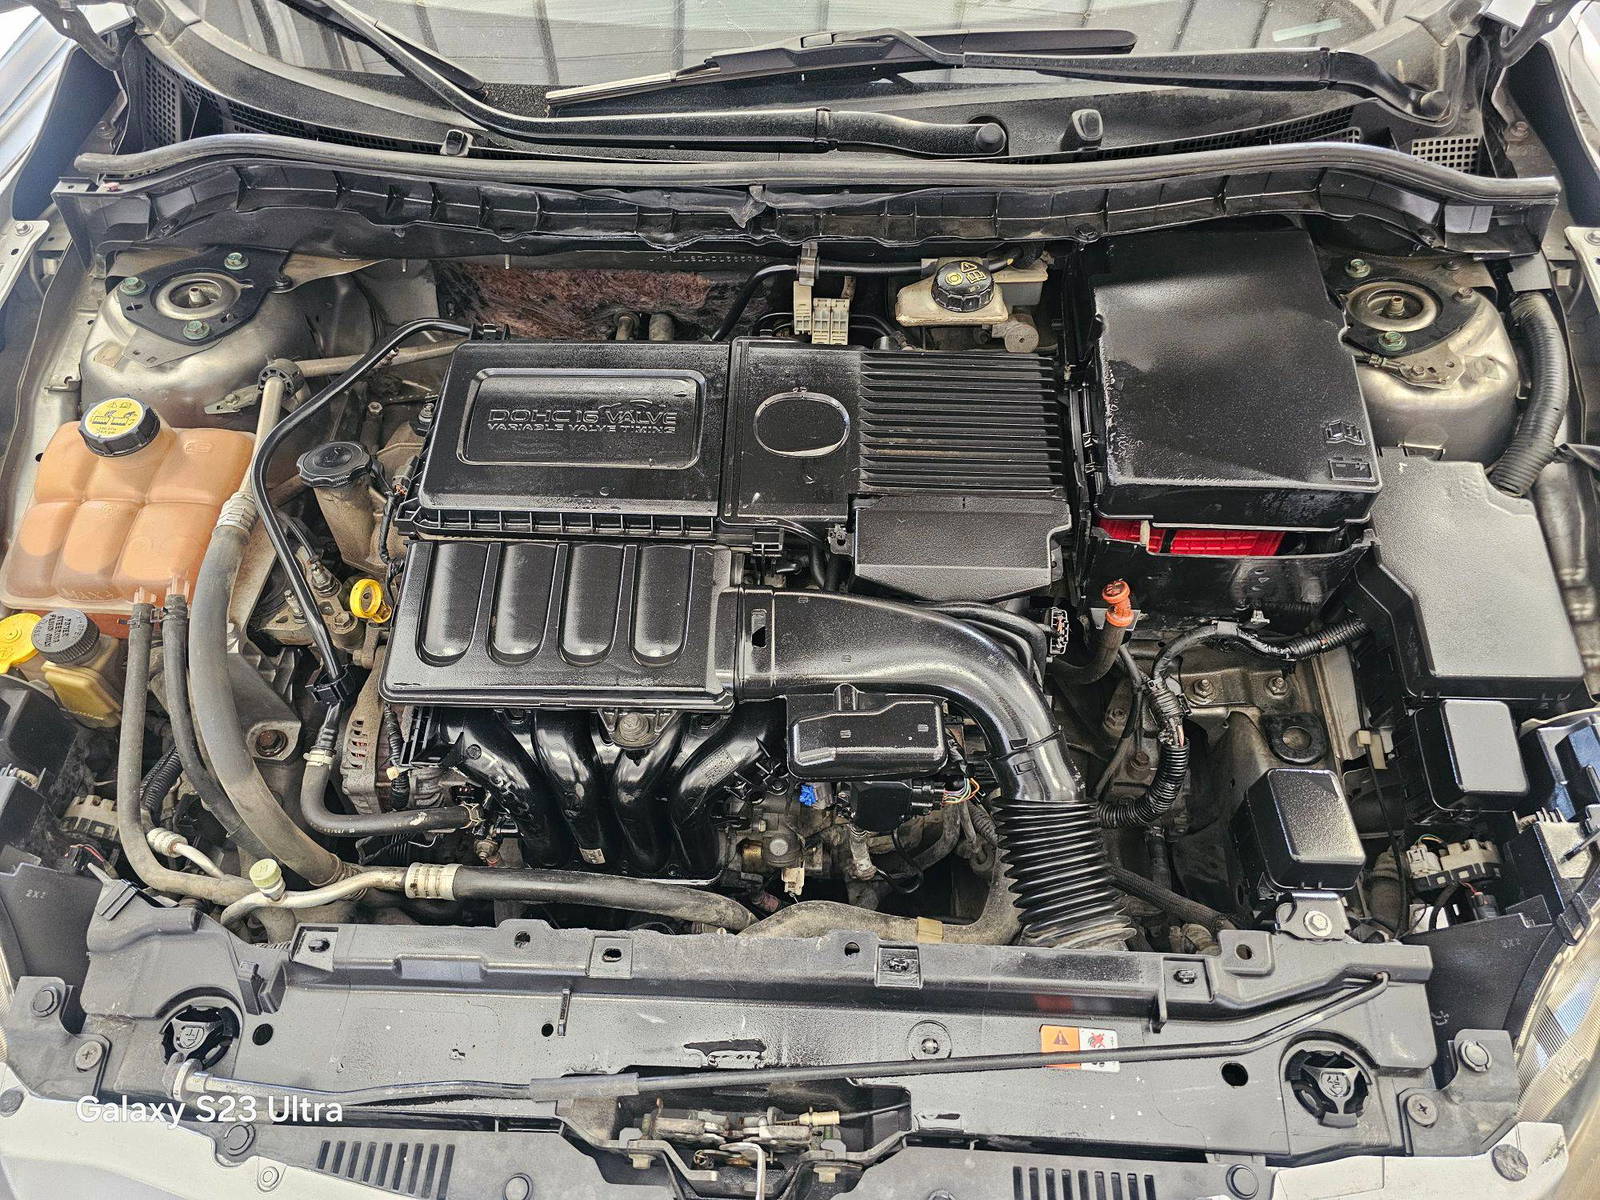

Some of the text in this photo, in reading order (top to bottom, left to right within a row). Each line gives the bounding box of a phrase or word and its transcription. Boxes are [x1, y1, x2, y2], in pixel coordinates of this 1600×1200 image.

[488, 409, 678, 425] DOHC 16 VALVE
[487, 423, 676, 434] VARIABLE VALVE TIMING
